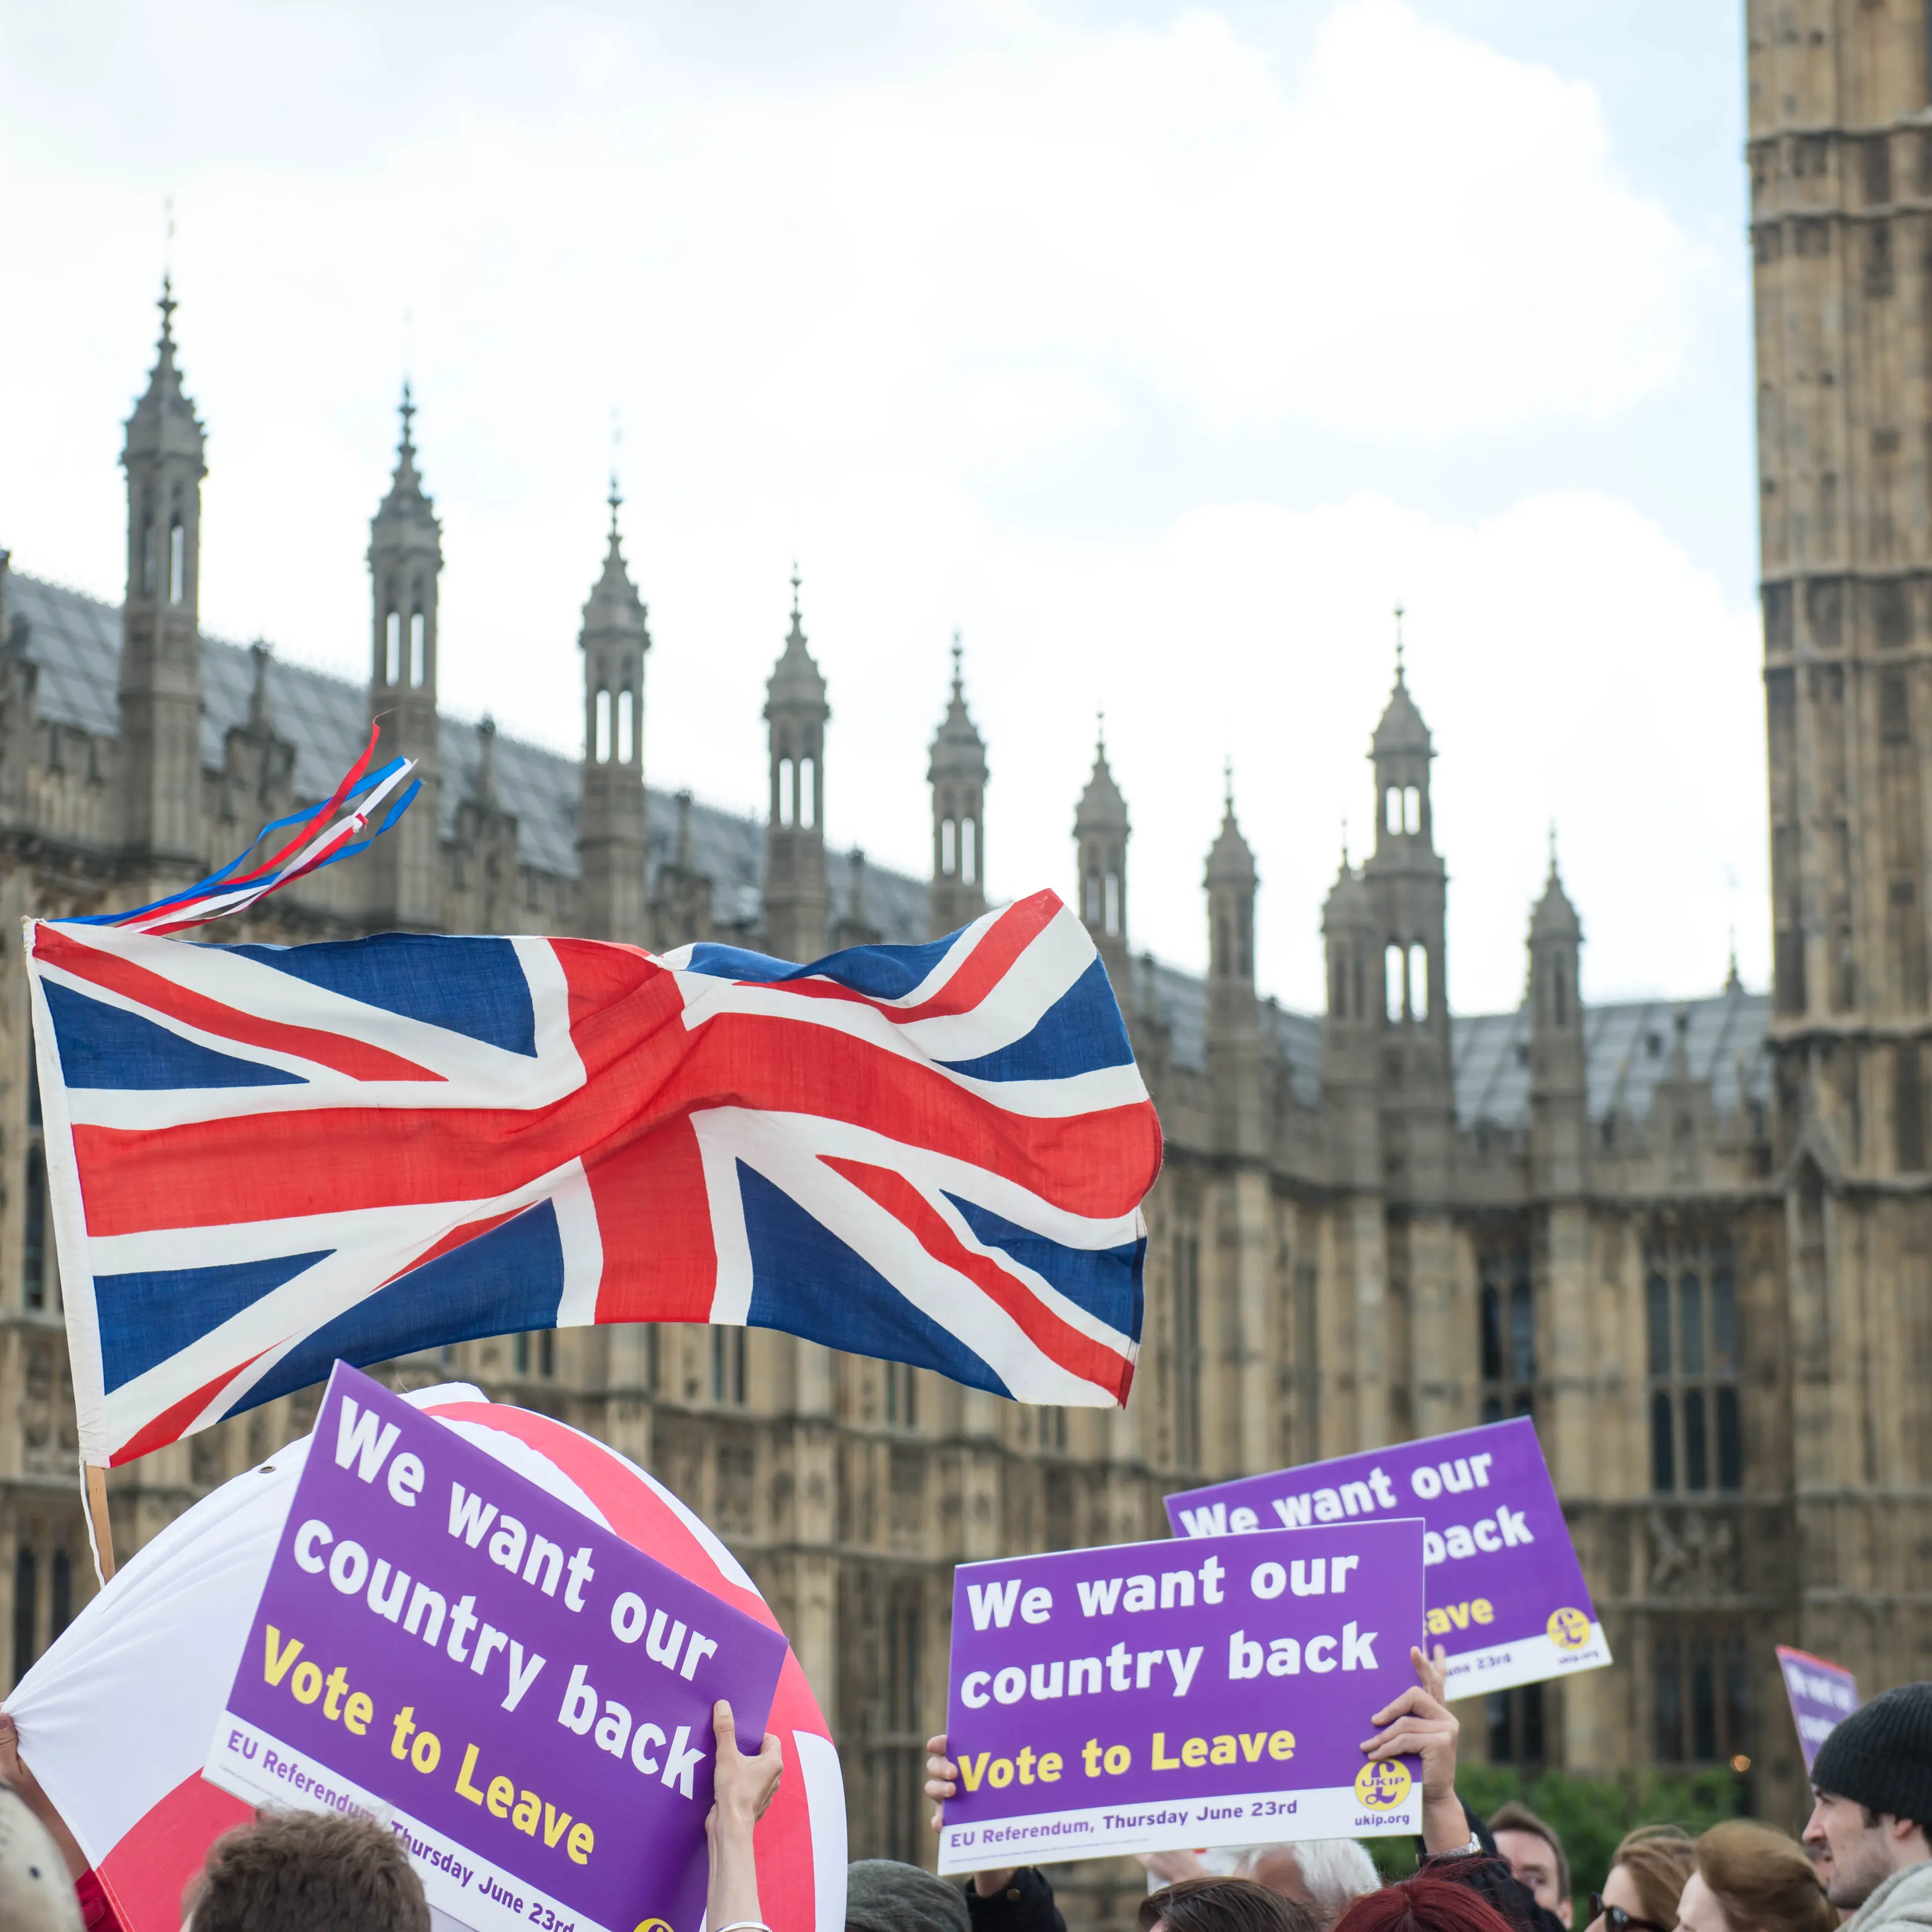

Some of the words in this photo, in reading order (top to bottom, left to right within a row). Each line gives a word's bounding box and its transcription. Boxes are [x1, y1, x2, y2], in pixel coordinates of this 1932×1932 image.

[1178, 1502, 1260, 1538] We
[1271, 1467, 1397, 1528] want
[1411, 1453, 1492, 1500] our
[335, 1395, 425, 1507] We
[448, 1481, 595, 1613] want
[610, 1591, 718, 1681] our
[966, 1579, 1053, 1631] We
[1076, 1555, 1226, 1618] want
[1250, 1555, 1359, 1600] our
[1423, 1598, 1495, 1636] ave
[293, 1519, 547, 1713] country
[557, 1664, 707, 1800] back
[960, 1642, 1204, 1709] country
[1228, 1621, 1379, 1680] back
[263, 1624, 374, 1736] Vote
[390, 1706, 442, 1774] to
[454, 1742, 594, 1865] Leave
[957, 1746, 1063, 1791] Vote
[1082, 1739, 1131, 1777] to
[1152, 1730, 1295, 1769] Leave
[1361, 1777, 1404, 1787] UKIP
[227, 1729, 258, 1759] EU
[391, 1820, 474, 1888] Thursday
[478, 1876, 524, 1914] June
[950, 1831, 975, 1848] EU
[983, 1820, 1095, 1843] Referendum,
[1103, 1810, 1188, 1829] Thursday
[1197, 1805, 1243, 1821] June
[1252, 1800, 1297, 1816] 23rd
[1355, 1814, 1409, 1826] ukip.org
